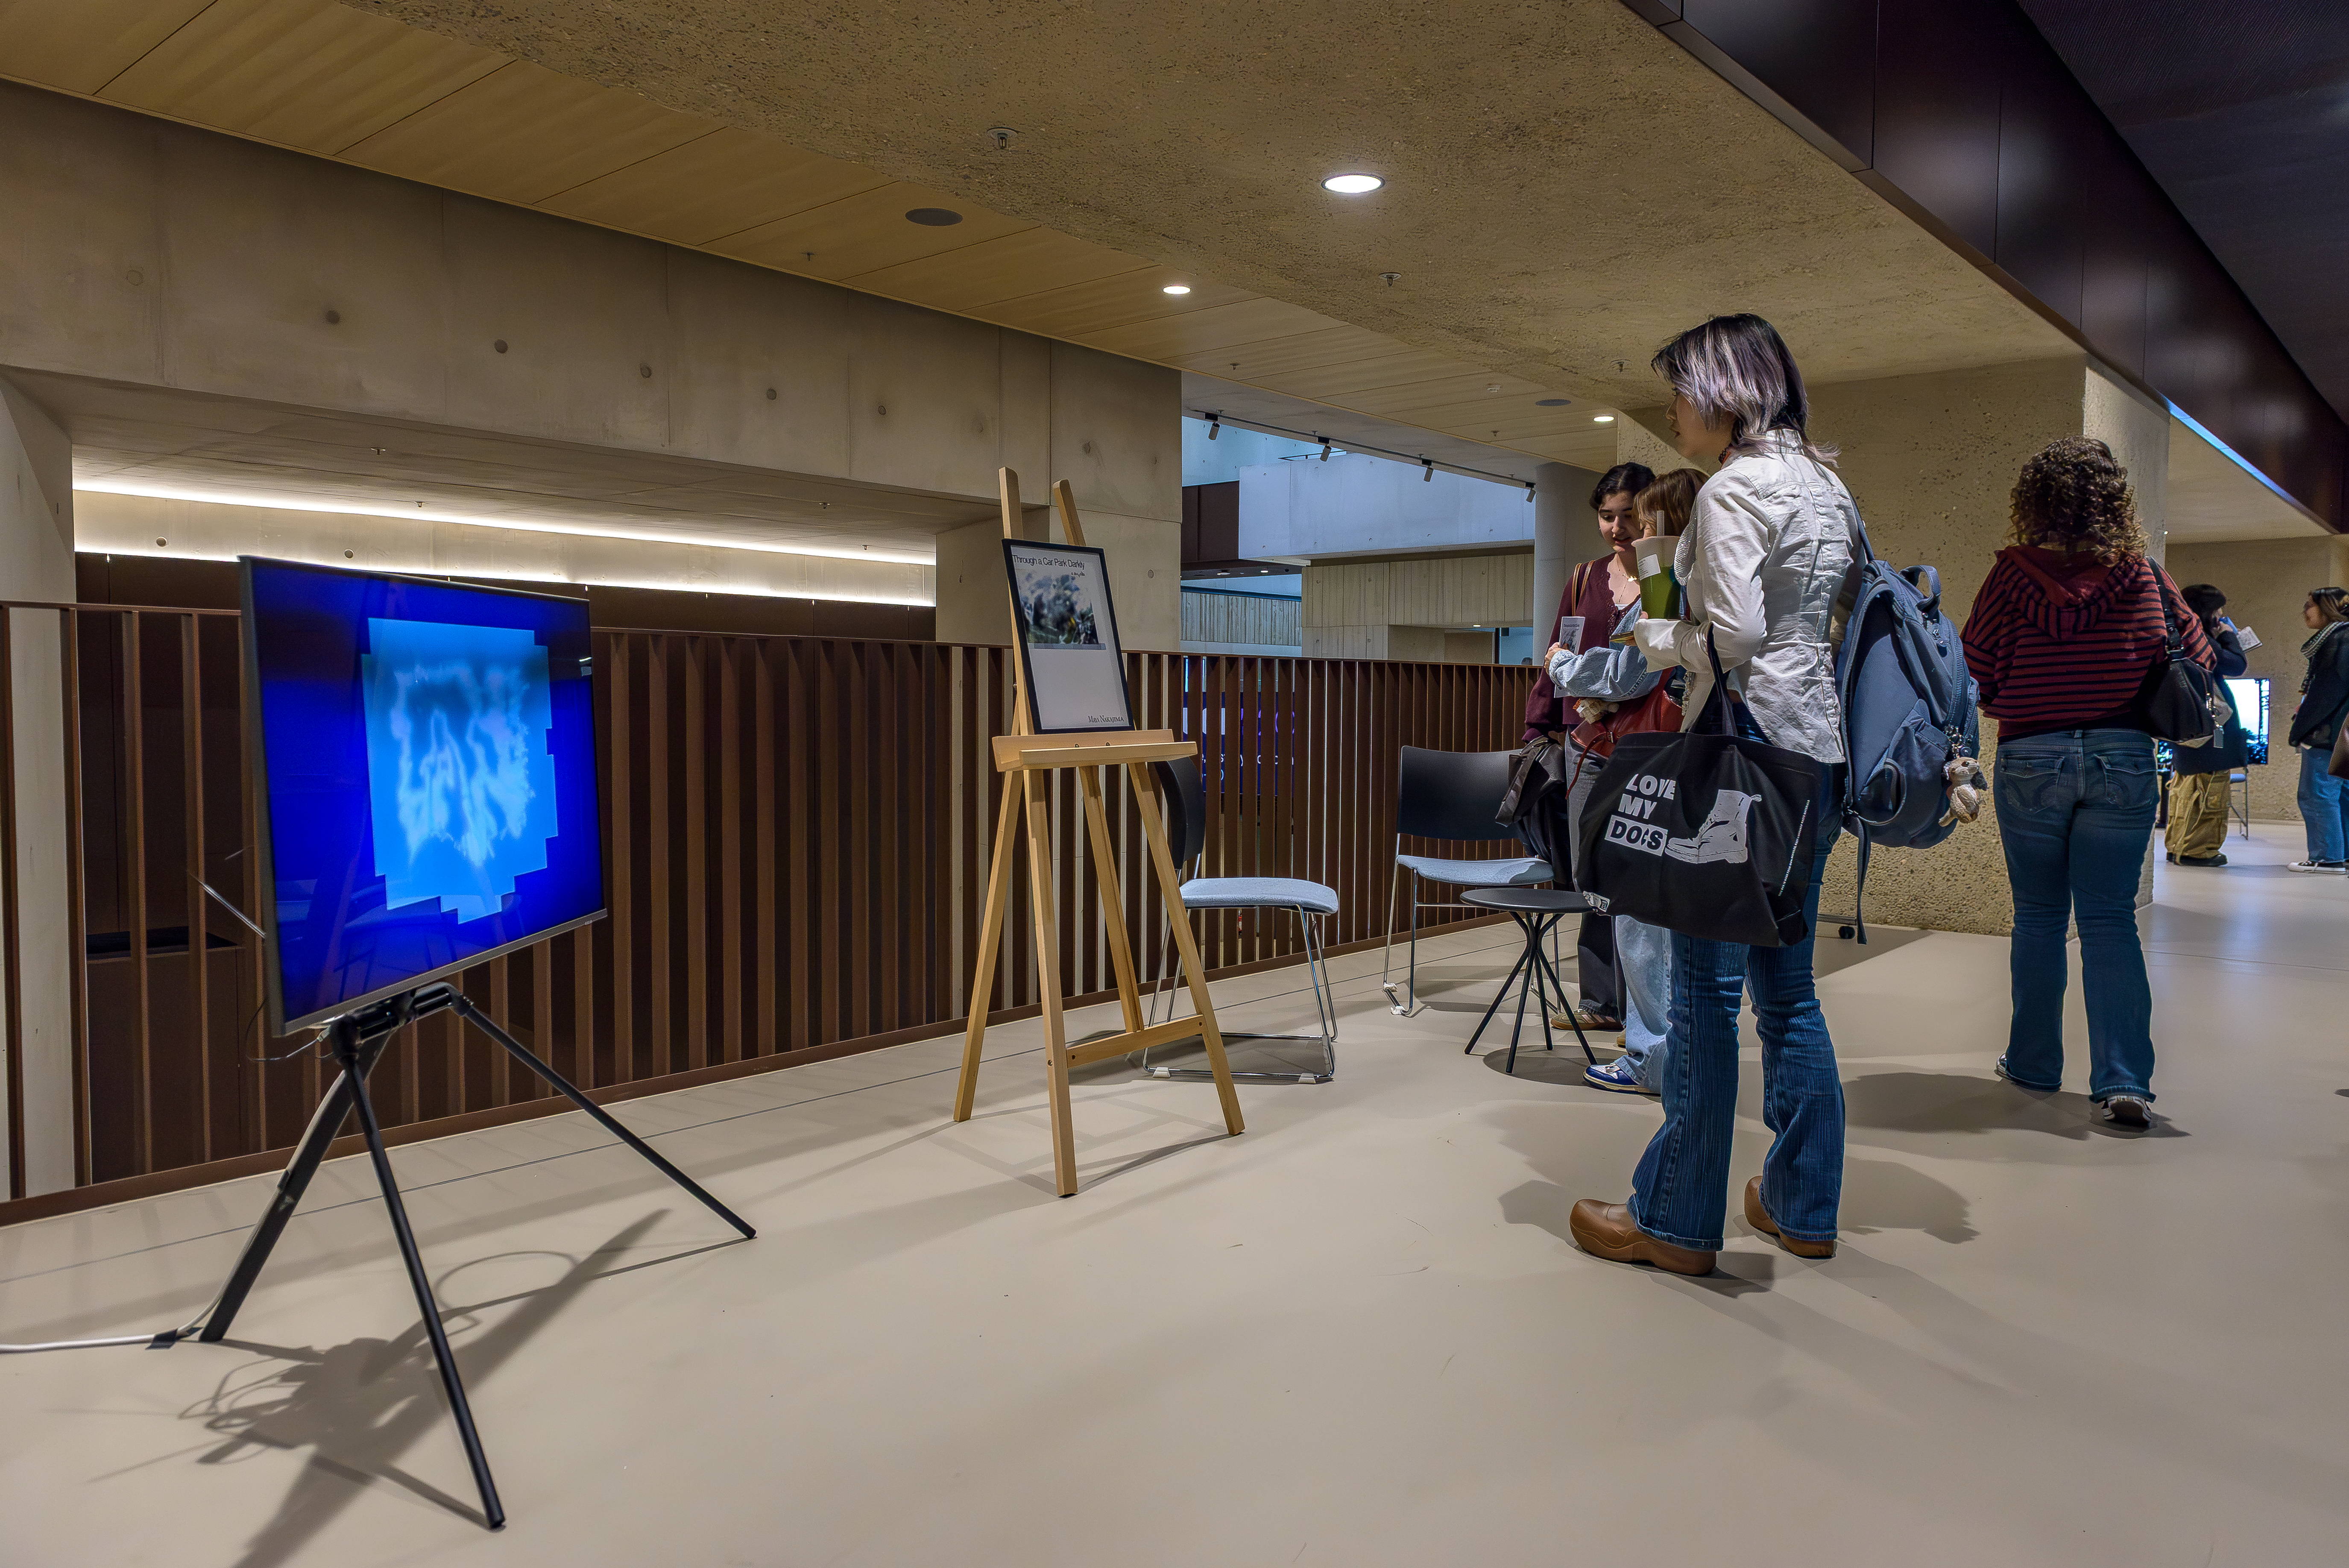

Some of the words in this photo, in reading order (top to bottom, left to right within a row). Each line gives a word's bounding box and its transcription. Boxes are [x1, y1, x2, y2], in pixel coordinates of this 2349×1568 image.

[1012, 555, 1037, 566] Through
[1043, 557, 1053, 566] Car
[1054, 558, 1067, 567] Park
[1068, 560, 1085, 570] Darkly
[1626, 774, 1676, 800] LOVE
[1618, 794, 1657, 819] MY
